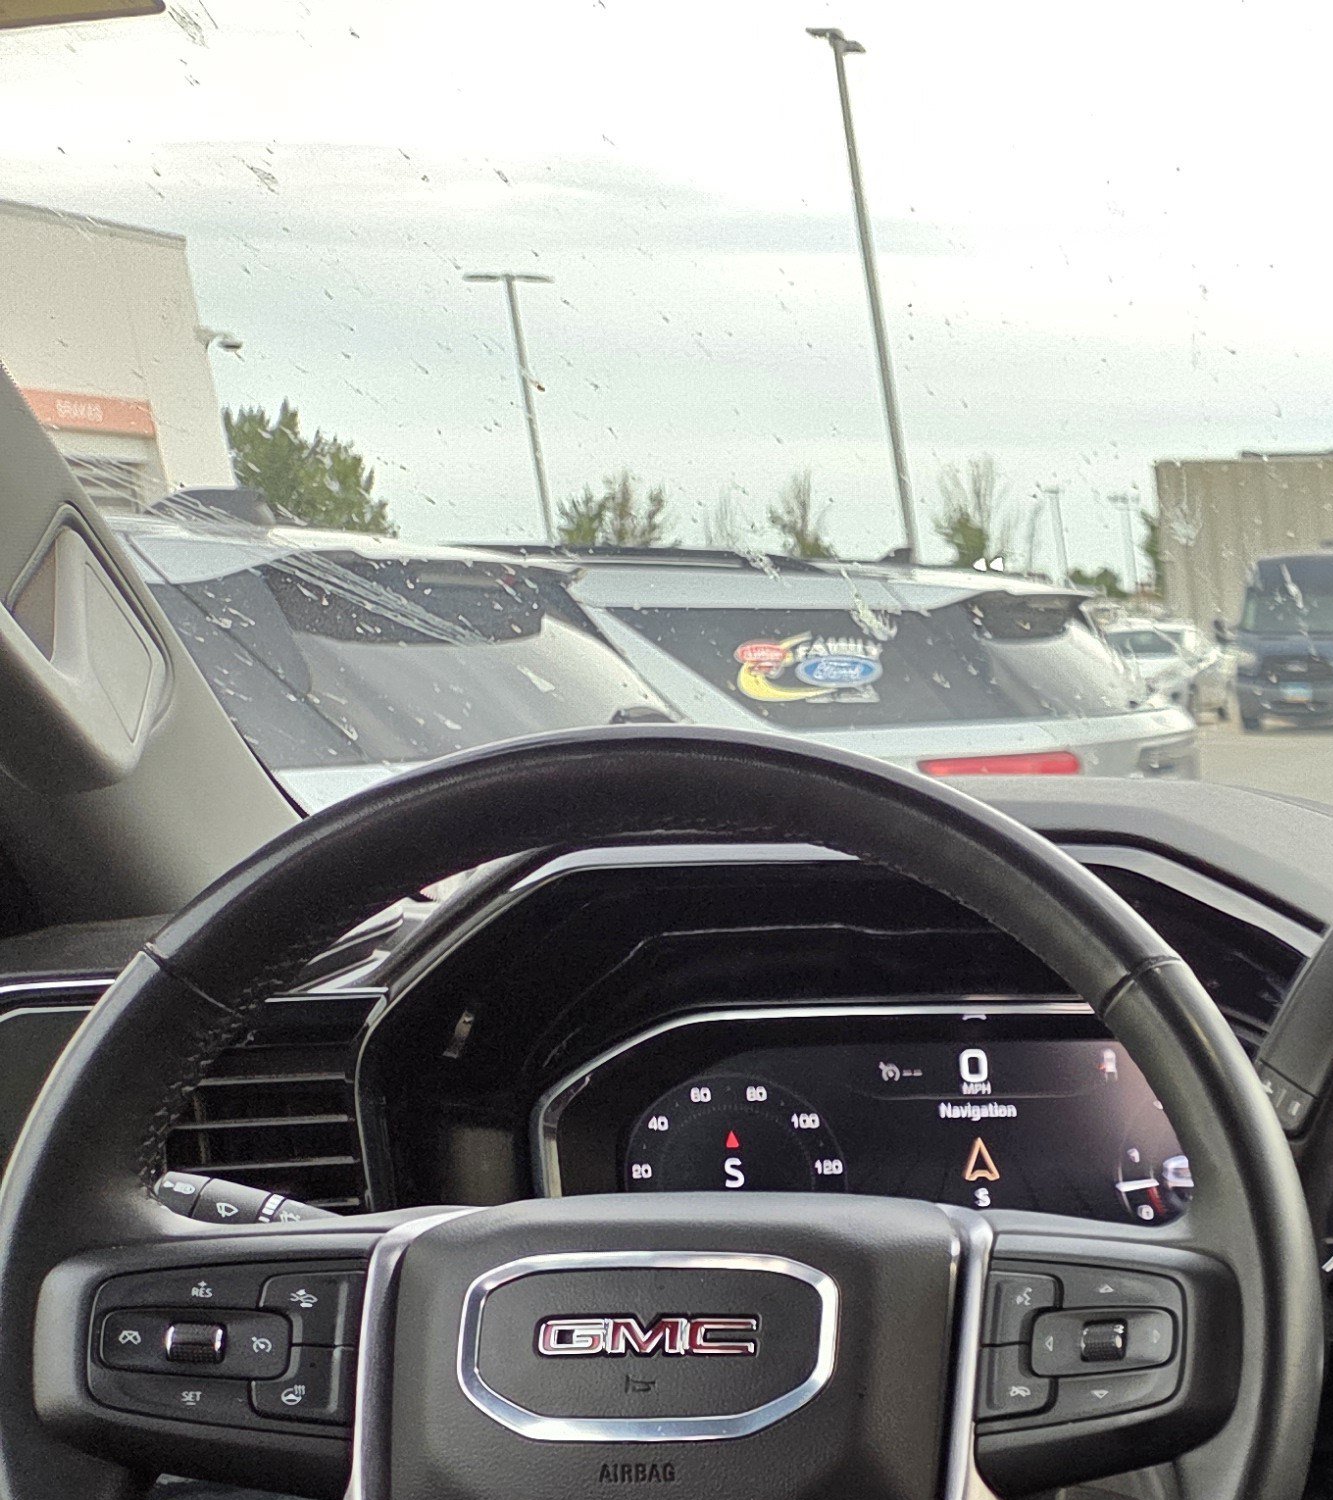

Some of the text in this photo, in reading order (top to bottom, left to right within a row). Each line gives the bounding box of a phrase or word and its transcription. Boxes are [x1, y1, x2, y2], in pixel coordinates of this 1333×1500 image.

[958, 1048, 989, 1083] 0
[961, 1082, 992, 1095] MPH
[790, 1112, 821, 1129] 100
[938, 1102, 1018, 1122] Navigation
[647, 1115, 669, 1132] 40
[723, 1157, 746, 1189] S
[191, 1286, 213, 1298] RES
[537, 1317, 758, 1356] GMC
[181, 1390, 202, 1402] SET
[599, 1462, 677, 1484] AIRBAG
